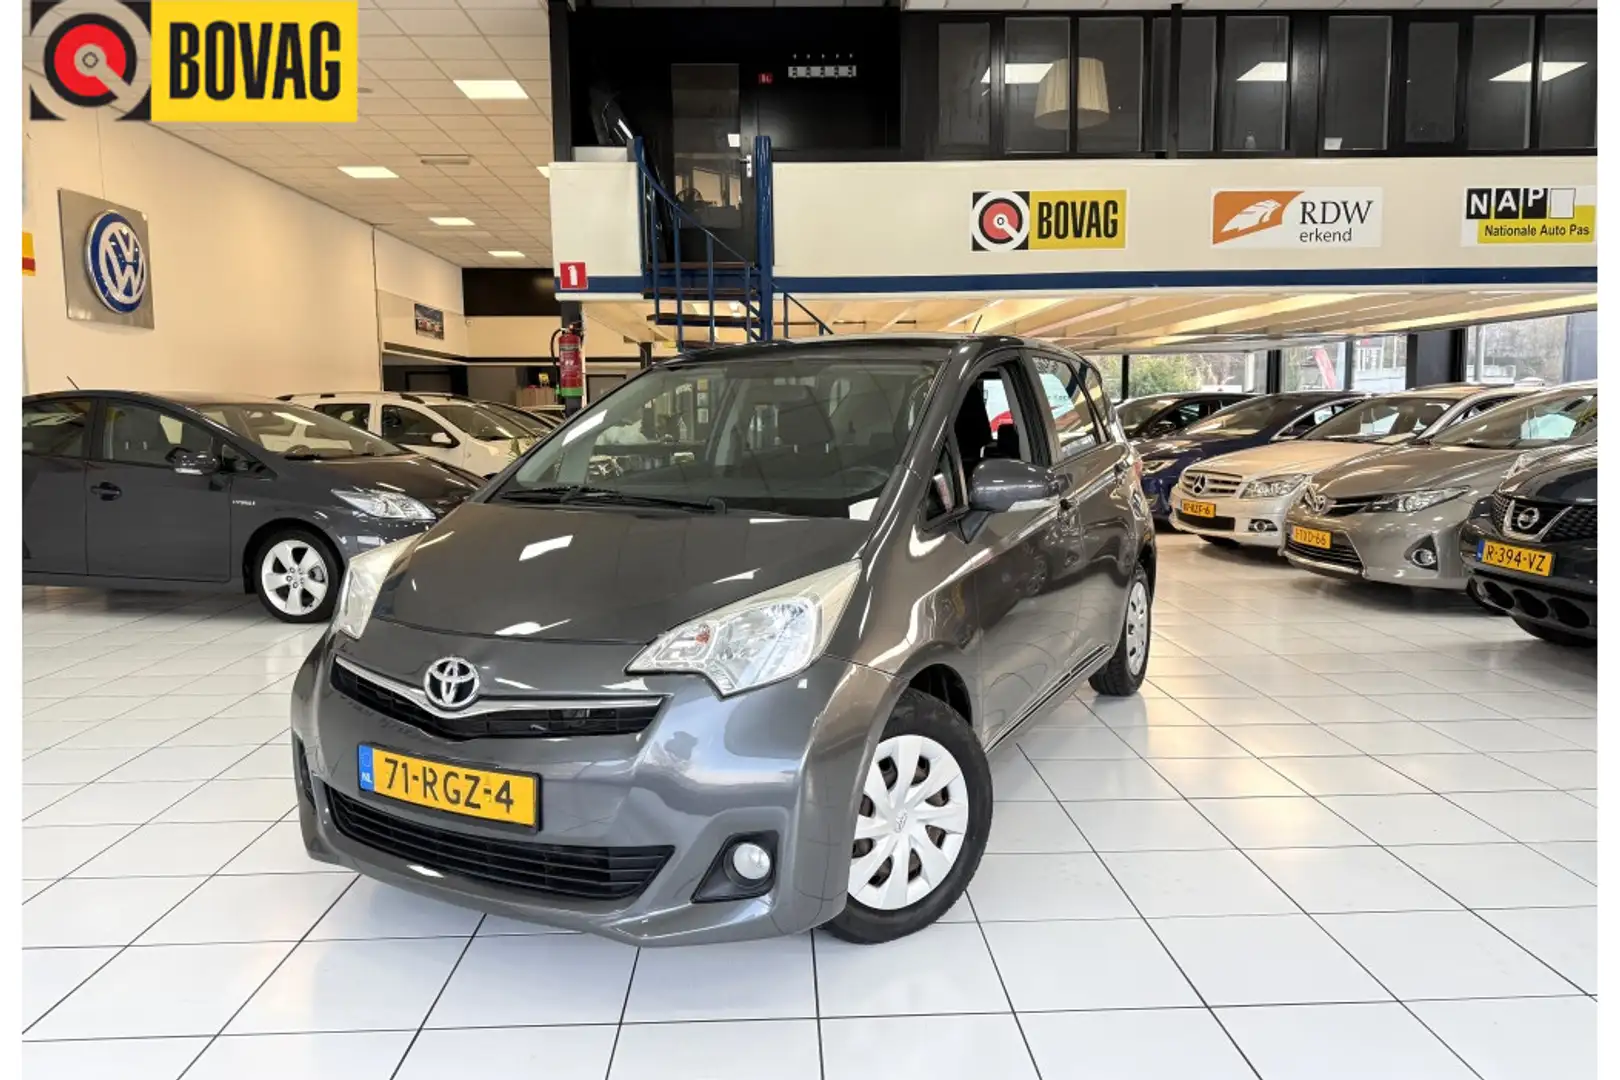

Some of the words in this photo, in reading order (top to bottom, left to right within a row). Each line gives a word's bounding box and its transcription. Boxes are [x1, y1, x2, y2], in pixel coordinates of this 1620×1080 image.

[1300, 200, 1374, 225] RDW
[1469, 187, 1545, 216] NAP
[1037, 200, 1118, 239] BOVAG
[1484, 224, 1537, 237] Nationale
[1540, 224, 1566, 236] Auto
[1570, 223, 1590, 236] Pas
[1300, 227, 1352, 242] erkend
[384, 756, 514, 815] 71-RGZ-4
